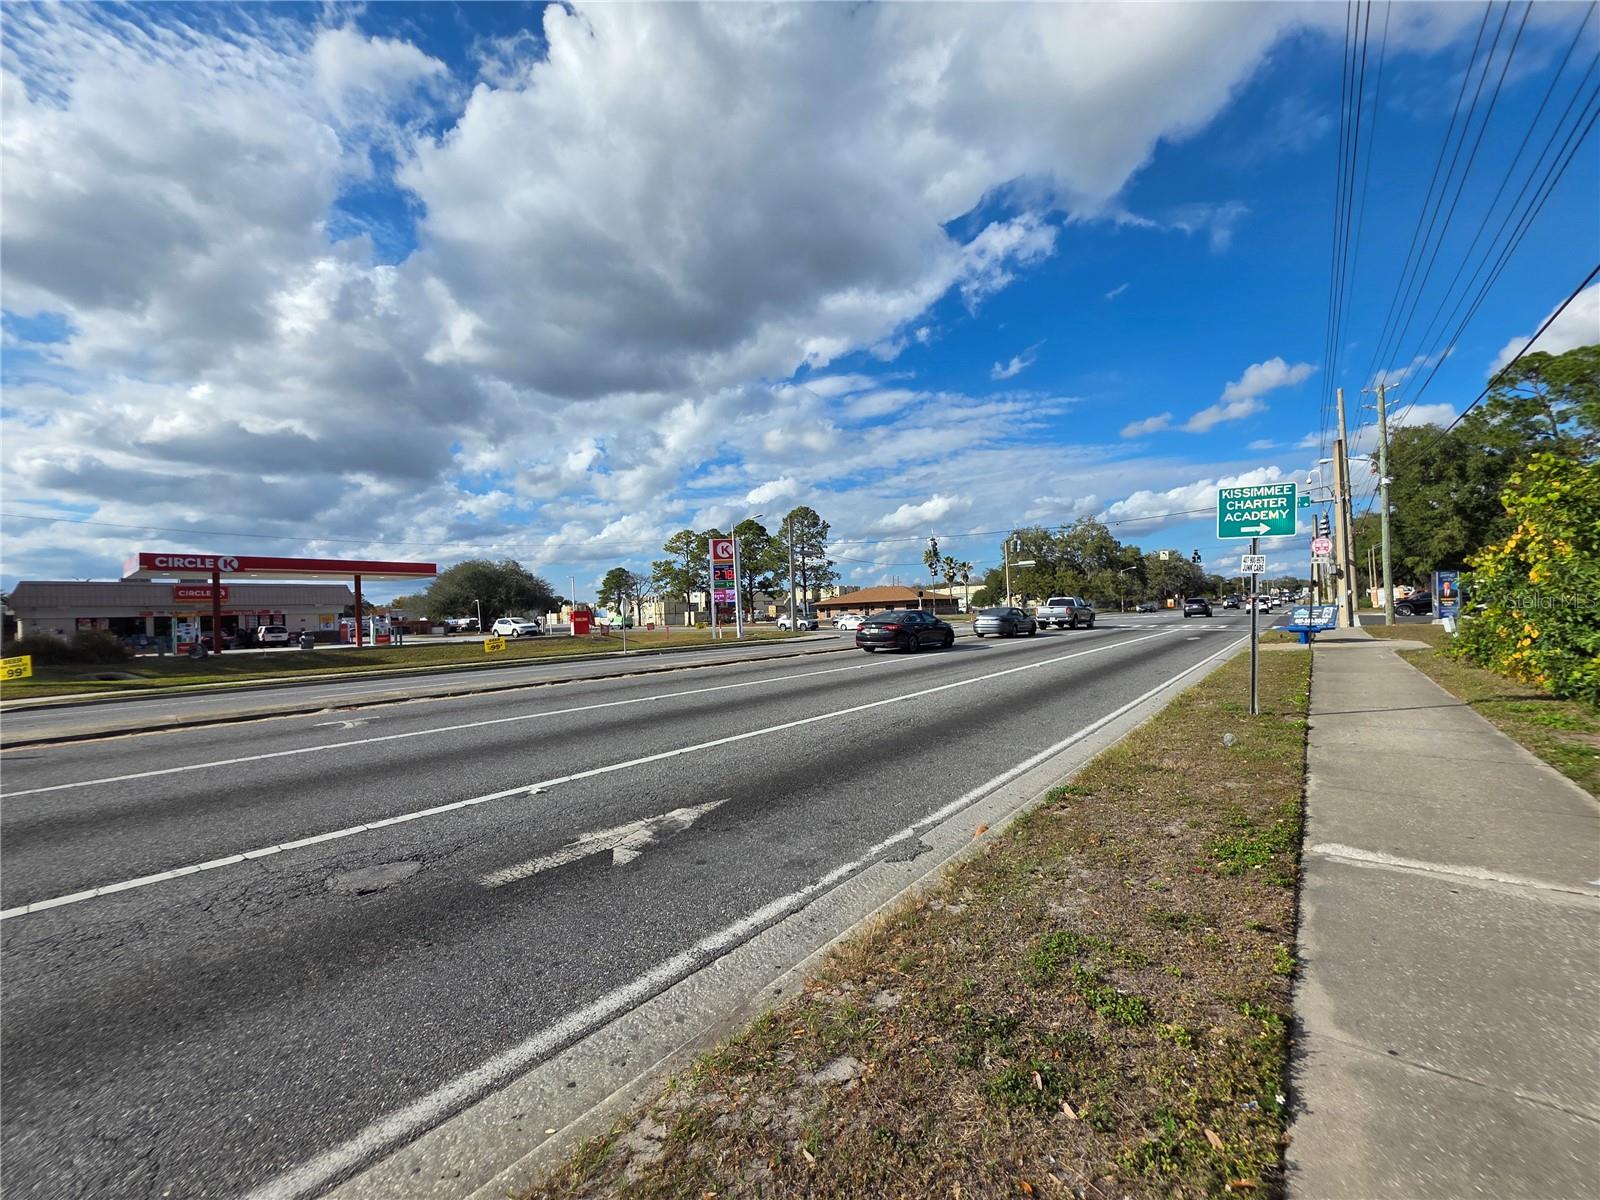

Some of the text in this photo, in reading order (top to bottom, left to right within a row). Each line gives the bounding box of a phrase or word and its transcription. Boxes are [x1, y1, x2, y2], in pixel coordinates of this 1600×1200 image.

[1222, 485, 1292, 499] KISSIMMEE
[1227, 498, 1287, 510] CHARTER
[1224, 509, 1290, 522] ACADEMY
[719, 543, 732, 557] K
[155, 557, 238, 572] CIRCLE K
[1254, 564, 1264, 572] CARS
[178, 588, 212, 598] CIRCLE
